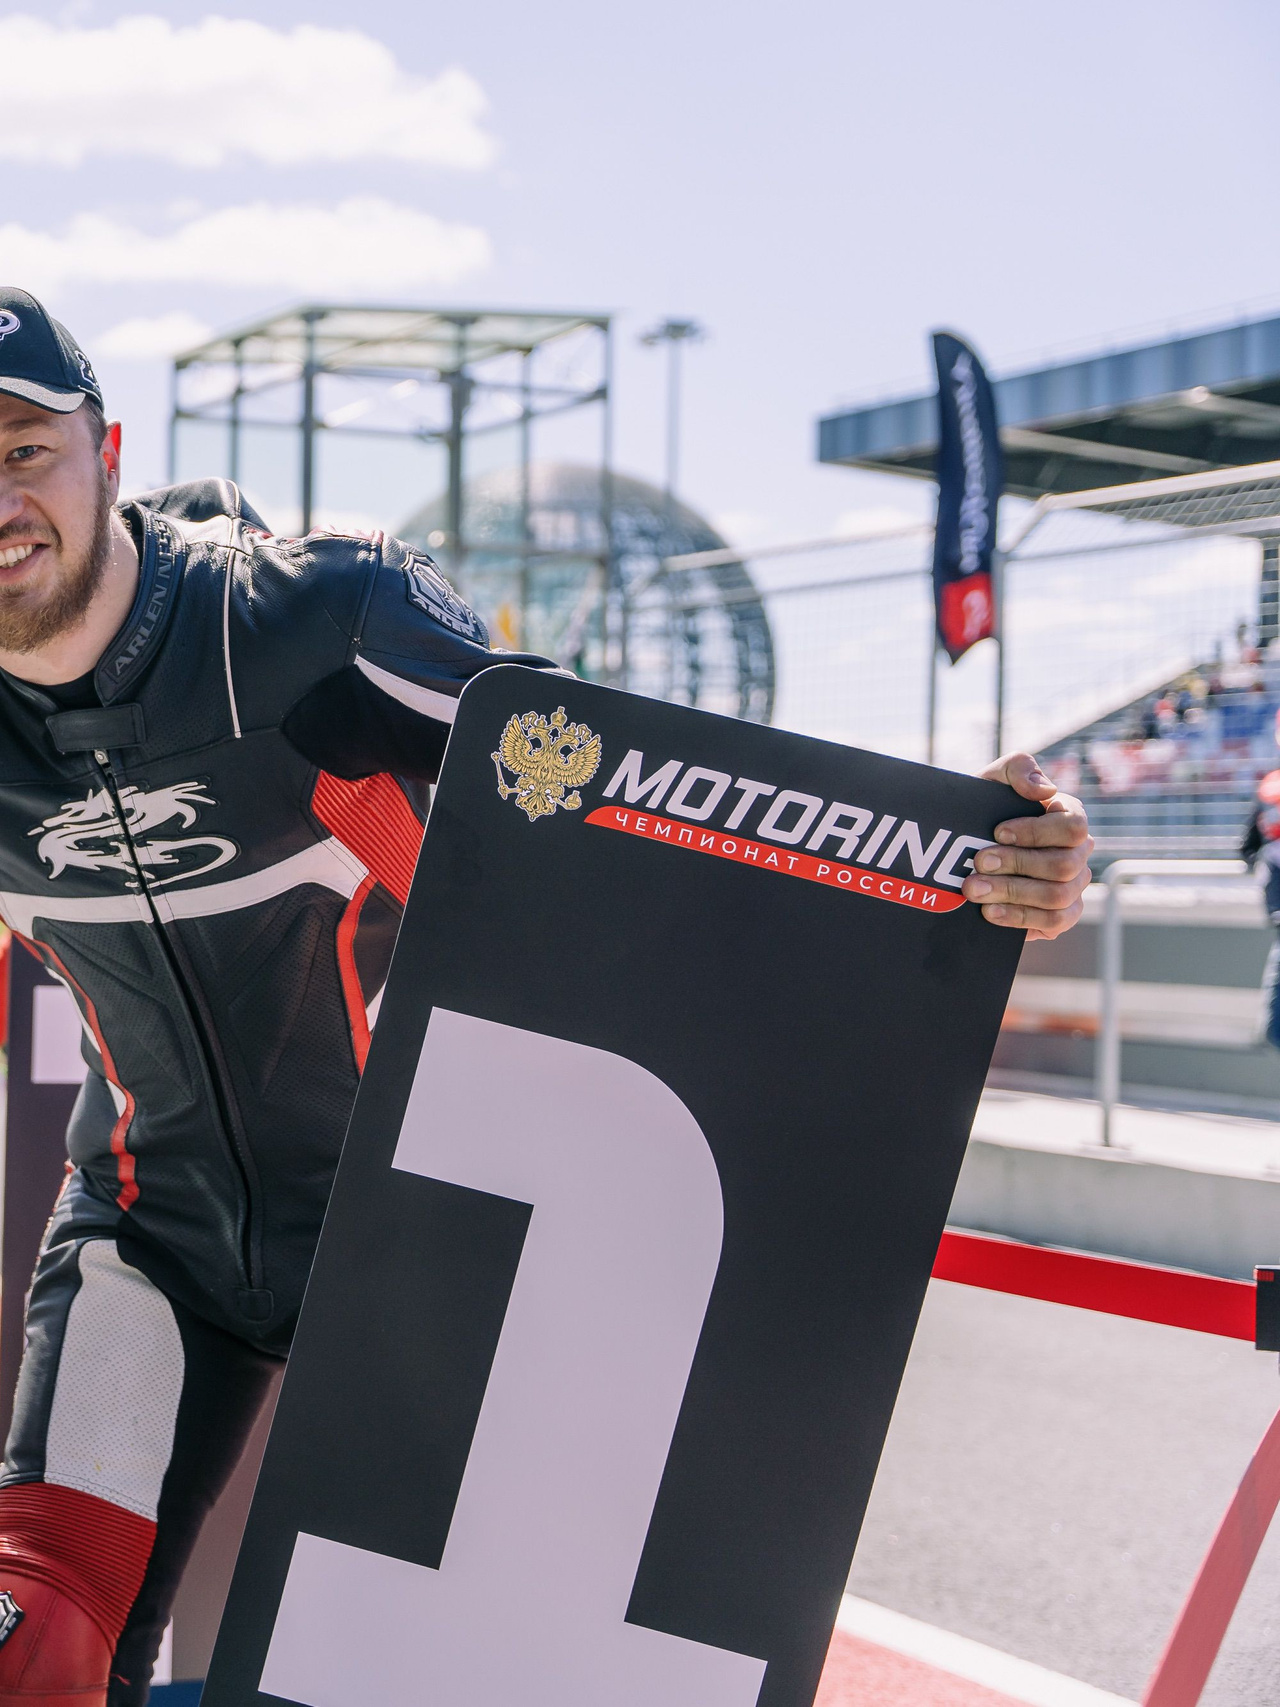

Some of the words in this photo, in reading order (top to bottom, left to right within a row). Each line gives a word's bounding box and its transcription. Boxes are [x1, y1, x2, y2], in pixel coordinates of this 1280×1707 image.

[114, 583, 168, 677] ARLEN
[602, 749, 997, 889] MOTORING
[615, 811, 799, 870] ЧЕМПИОНАТ
[816, 864, 938, 907] РОССИИ
[258, 1006, 769, 1707] 1
